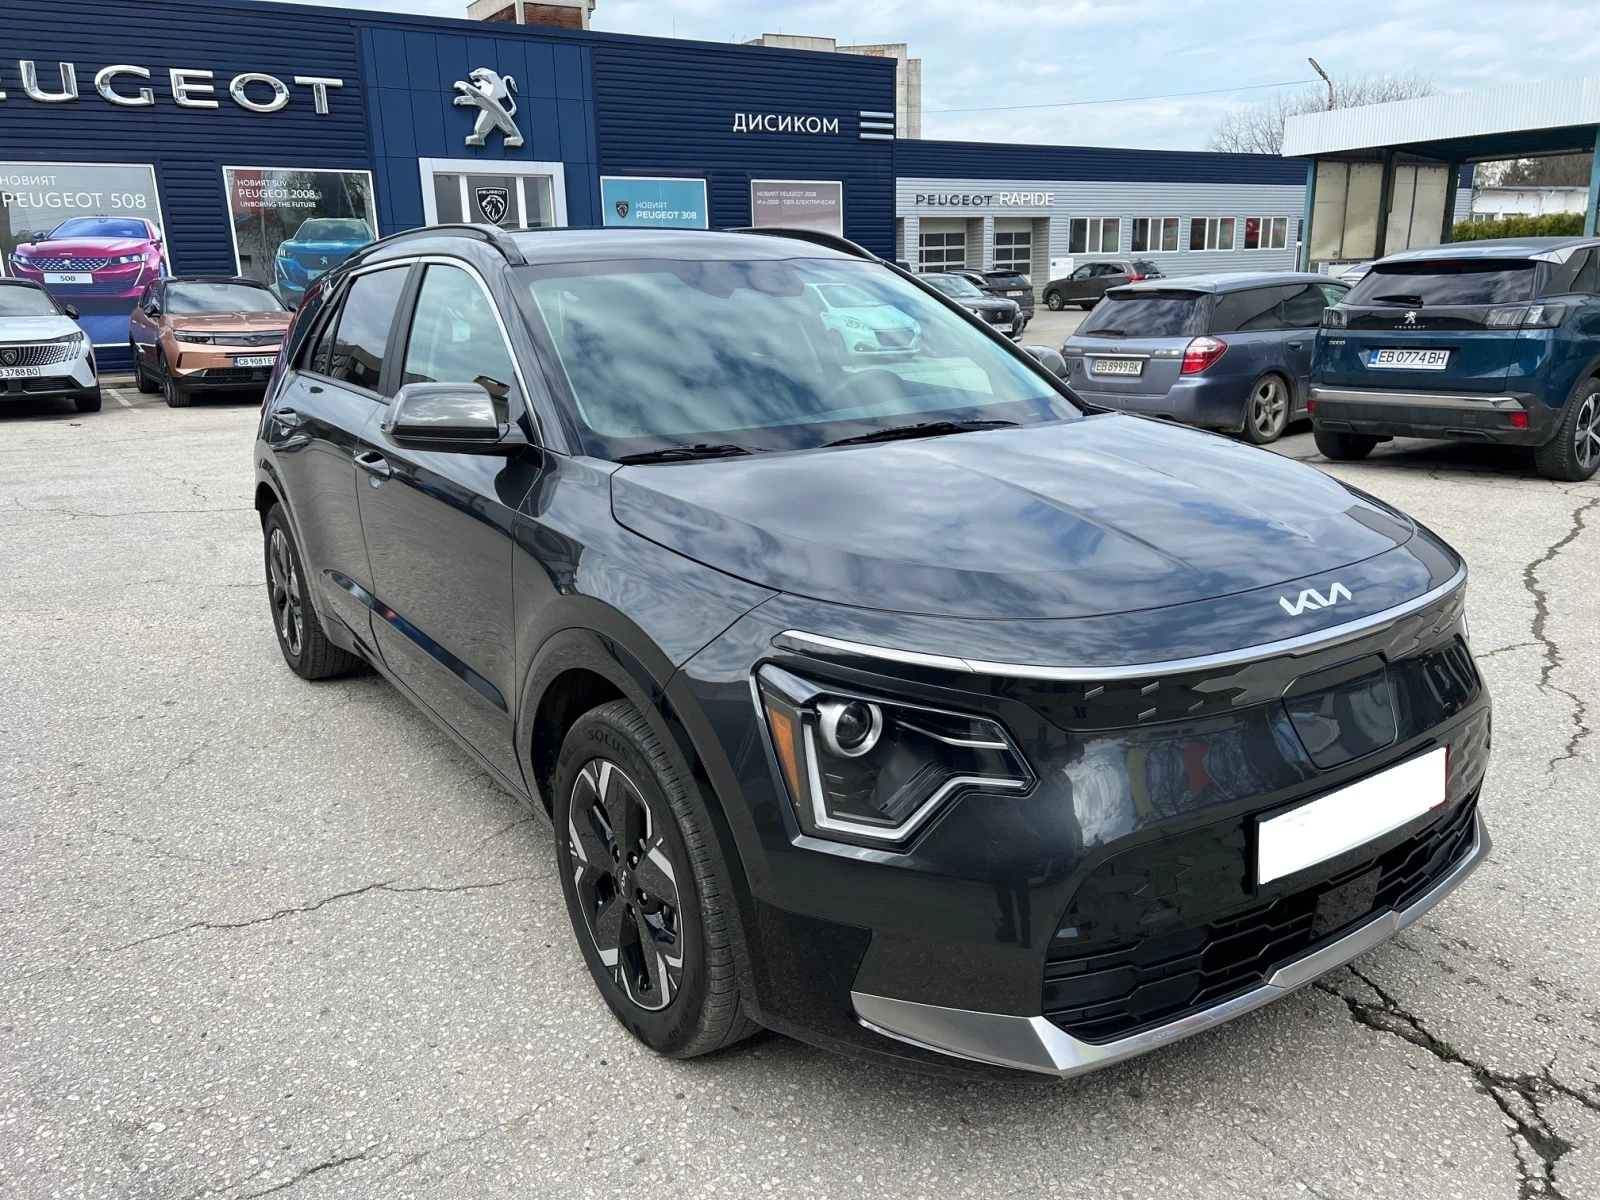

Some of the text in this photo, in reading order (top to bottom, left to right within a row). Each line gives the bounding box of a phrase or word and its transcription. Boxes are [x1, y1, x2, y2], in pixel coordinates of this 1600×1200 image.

[0, 59, 343, 115] UGEOT
[733, 113, 839, 133] ДИСИКОМ
[0, 175, 57, 186] НОВИЯТ
[2, 193, 147, 209] PEUGEOT 508
[238, 189, 315, 199] PEUGEOT 2008
[915, 192, 1055, 206] PEUGEOT RAPIDE
[635, 201, 668, 209] НОВИЯТ
[636, 211, 697, 220] PEUGEOT 308
[588, 729, 629, 761] SOLUS
